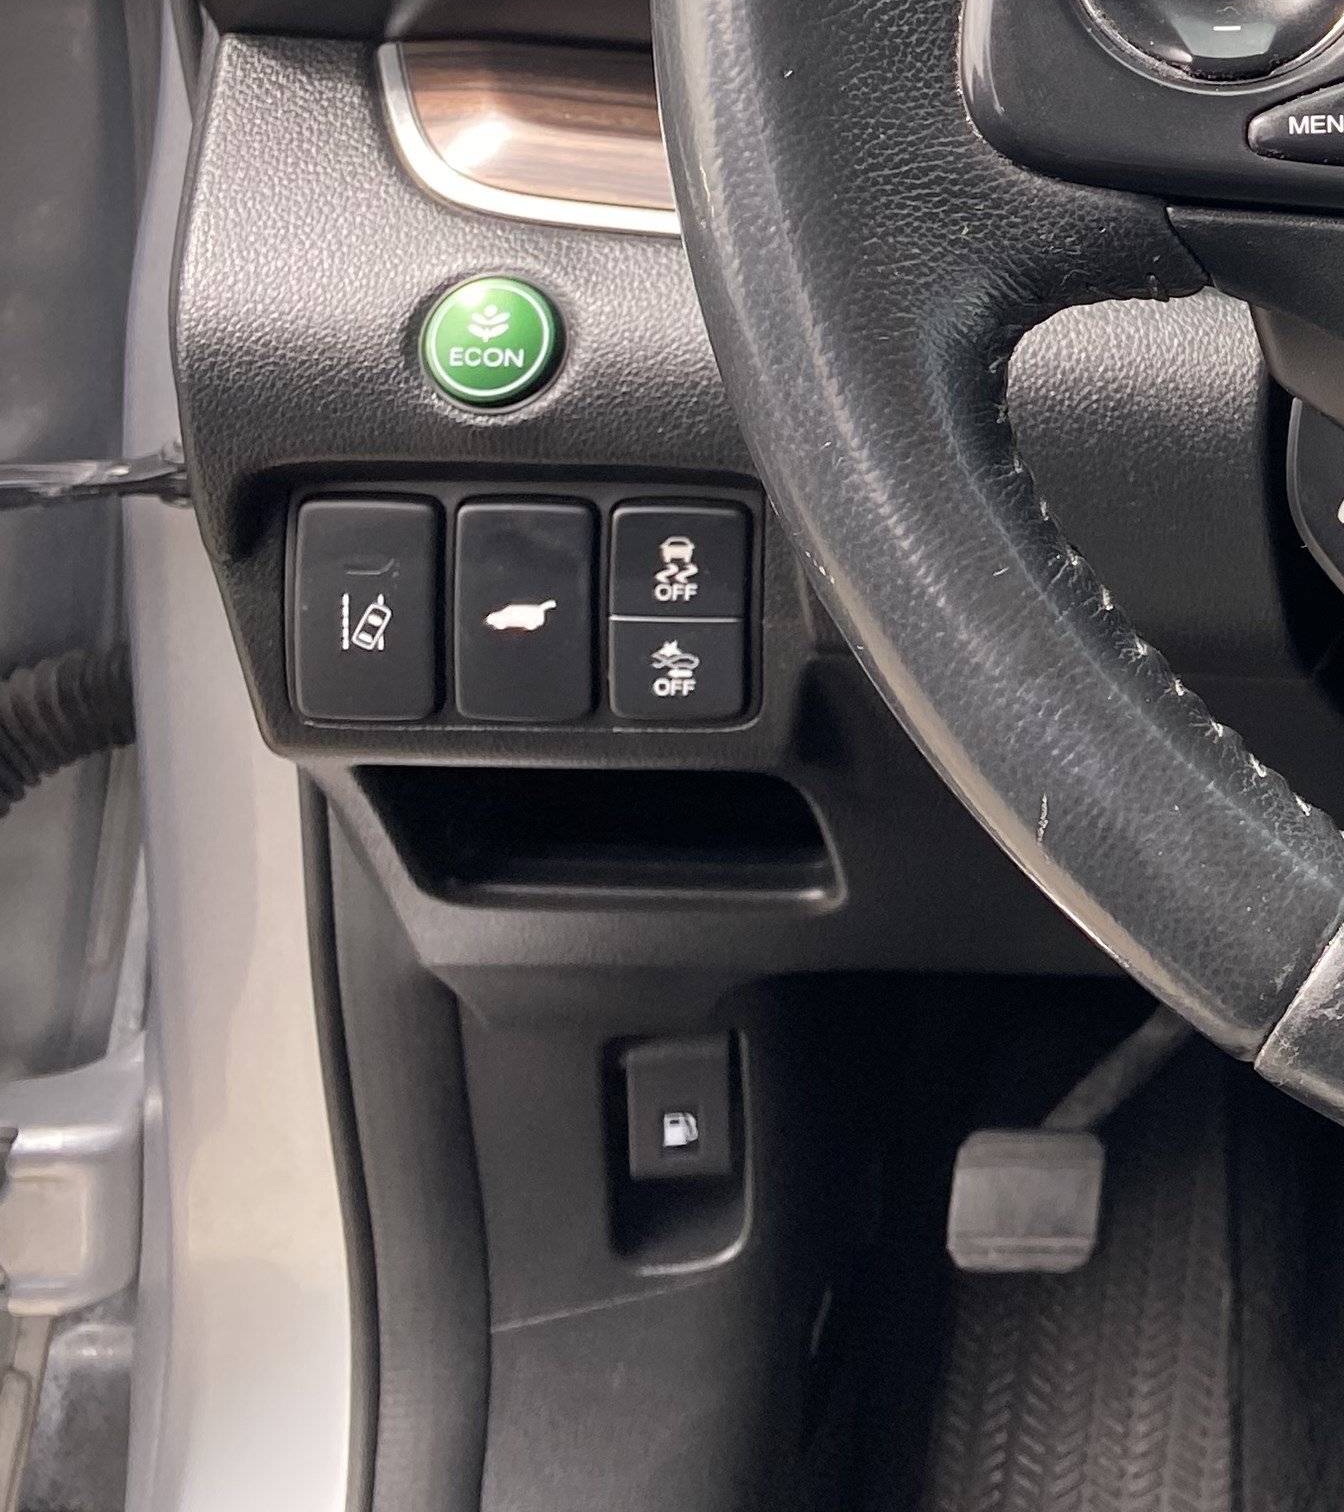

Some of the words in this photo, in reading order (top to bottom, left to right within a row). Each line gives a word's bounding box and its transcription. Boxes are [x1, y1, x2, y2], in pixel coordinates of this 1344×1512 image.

[448, 346, 525, 369] ECON
[654, 583, 698, 602] OFF
[652, 678, 696, 697] OFF
